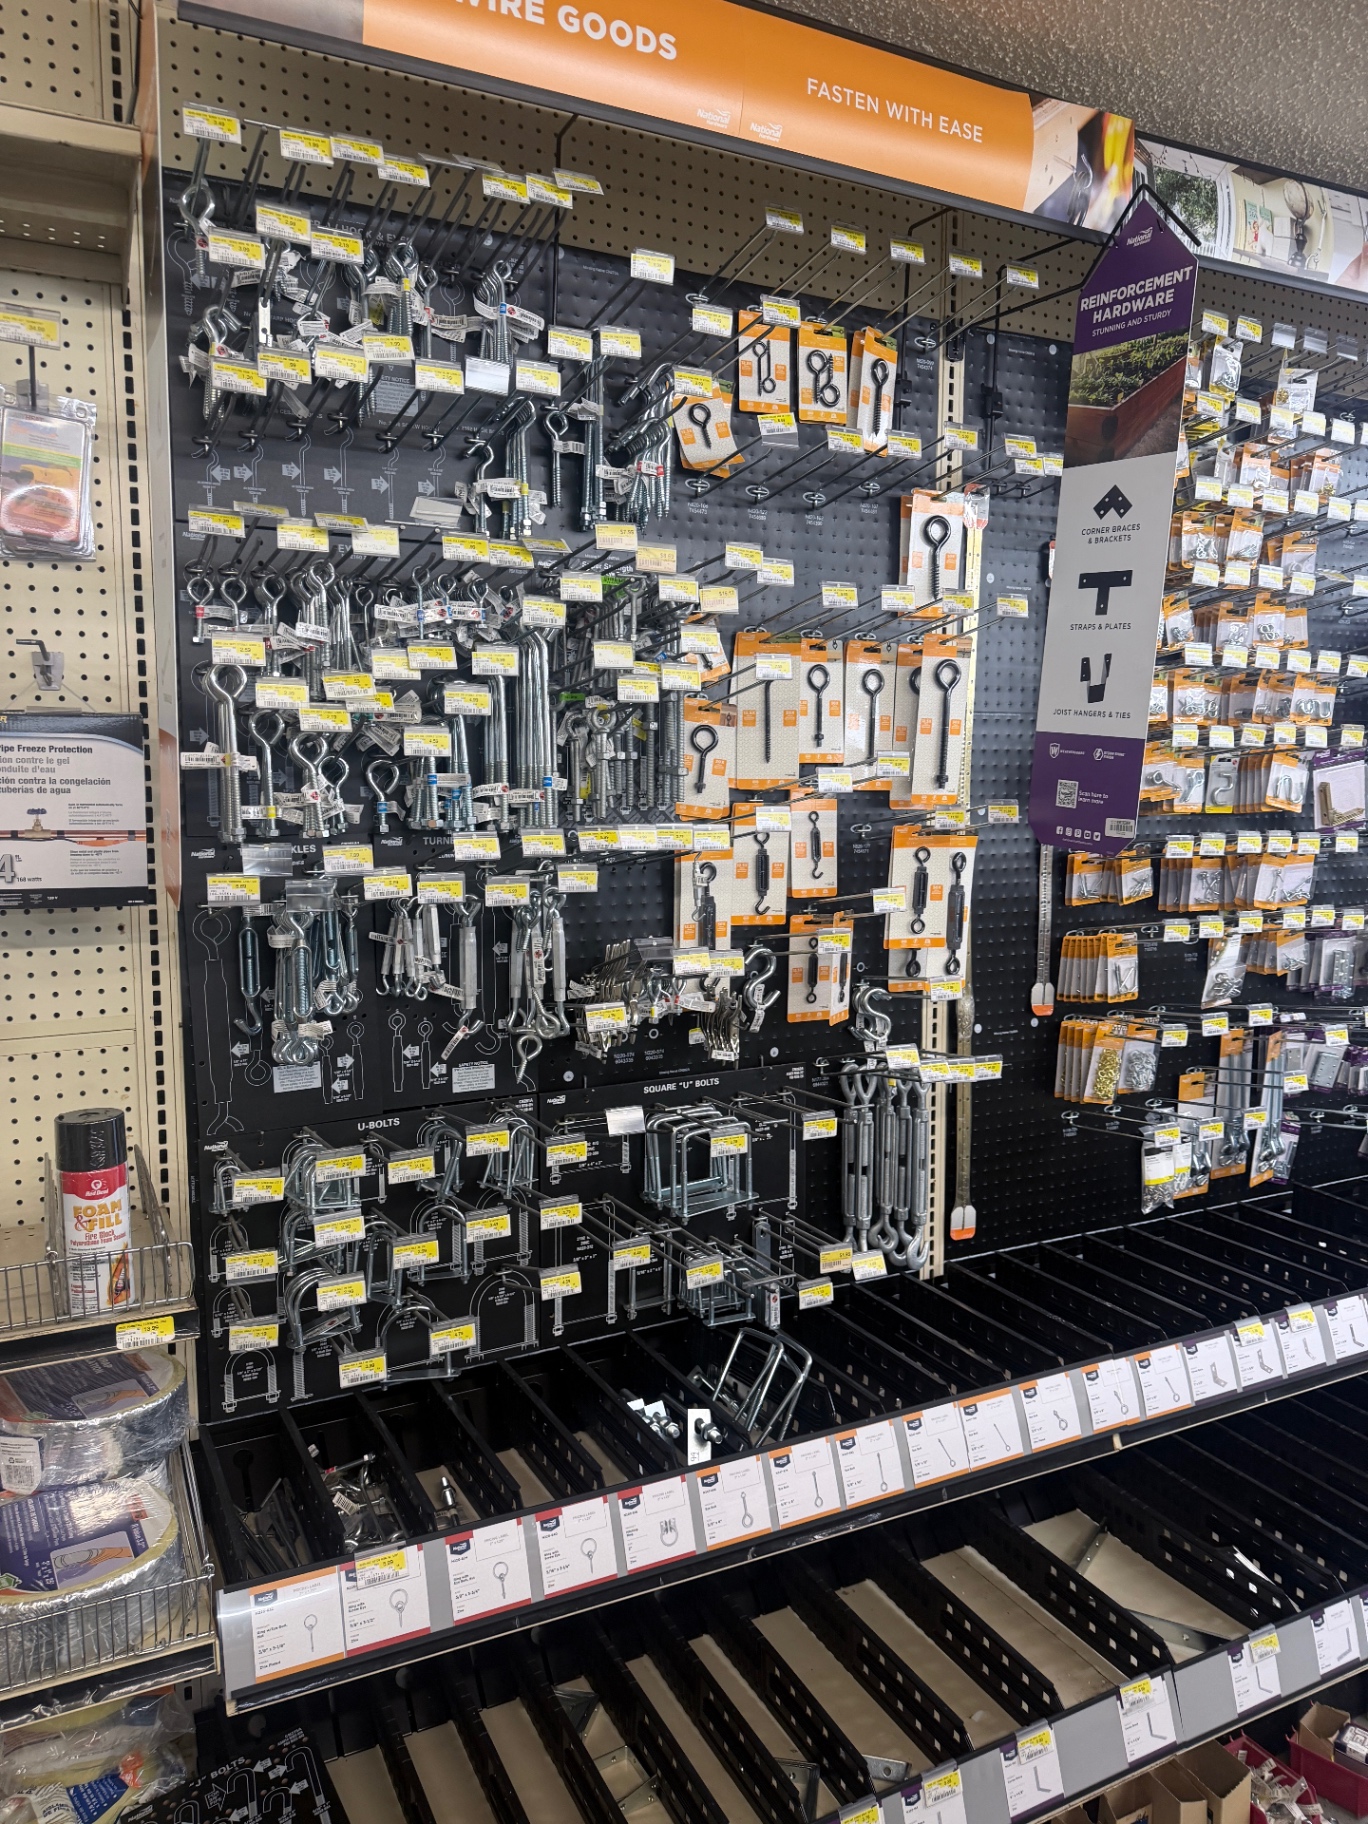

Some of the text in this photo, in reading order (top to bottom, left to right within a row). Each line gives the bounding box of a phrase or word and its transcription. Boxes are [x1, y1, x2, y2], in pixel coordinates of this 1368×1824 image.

[558, 5, 677, 60] GOODS
[697, 108, 730, 124] National
[807, 78, 983, 143] FASTEN WITH EASE
[750, 122, 783, 138] National
[1080, 266, 1193, 311] REINFORCEMENT
[1092, 289, 1175, 324] HARDWARE
[1092, 309, 1172, 337] STUNNING AND STURDY
[1081, 523, 1141, 536] CORNER BRACES
[1094, 534, 1132, 544] BRACKETS
[1070, 623, 1096, 631] STRAPS
[1104, 622, 1132, 630] PLATES
[1053, 708, 1131, 719] JOIST HANGERS & TIES
[17, 744, 47, 753] Freeze
[48, 745, 93, 754] Protection
[15, 756, 44, 765] contre
[46, 756, 54, 765] le
[31, 765, 56, 773] d'eau
[18, 777, 46, 785] contra
[48, 777, 57, 785] la
[59, 777, 111, 787] congelación
[36, 786, 47, 794] de
[49, 787, 71, 796] agua
[643, 1077, 720, 1094] SQUARE "U" BOLTS
[357, 1117, 401, 1131] U-BOLTS
[73, 1199, 122, 1218] FOAM
[74, 1213, 122, 1233] & FILL
[85, 1229, 115, 1241] Fire Block
[210, 1756, 246, 1779] BOLTS
